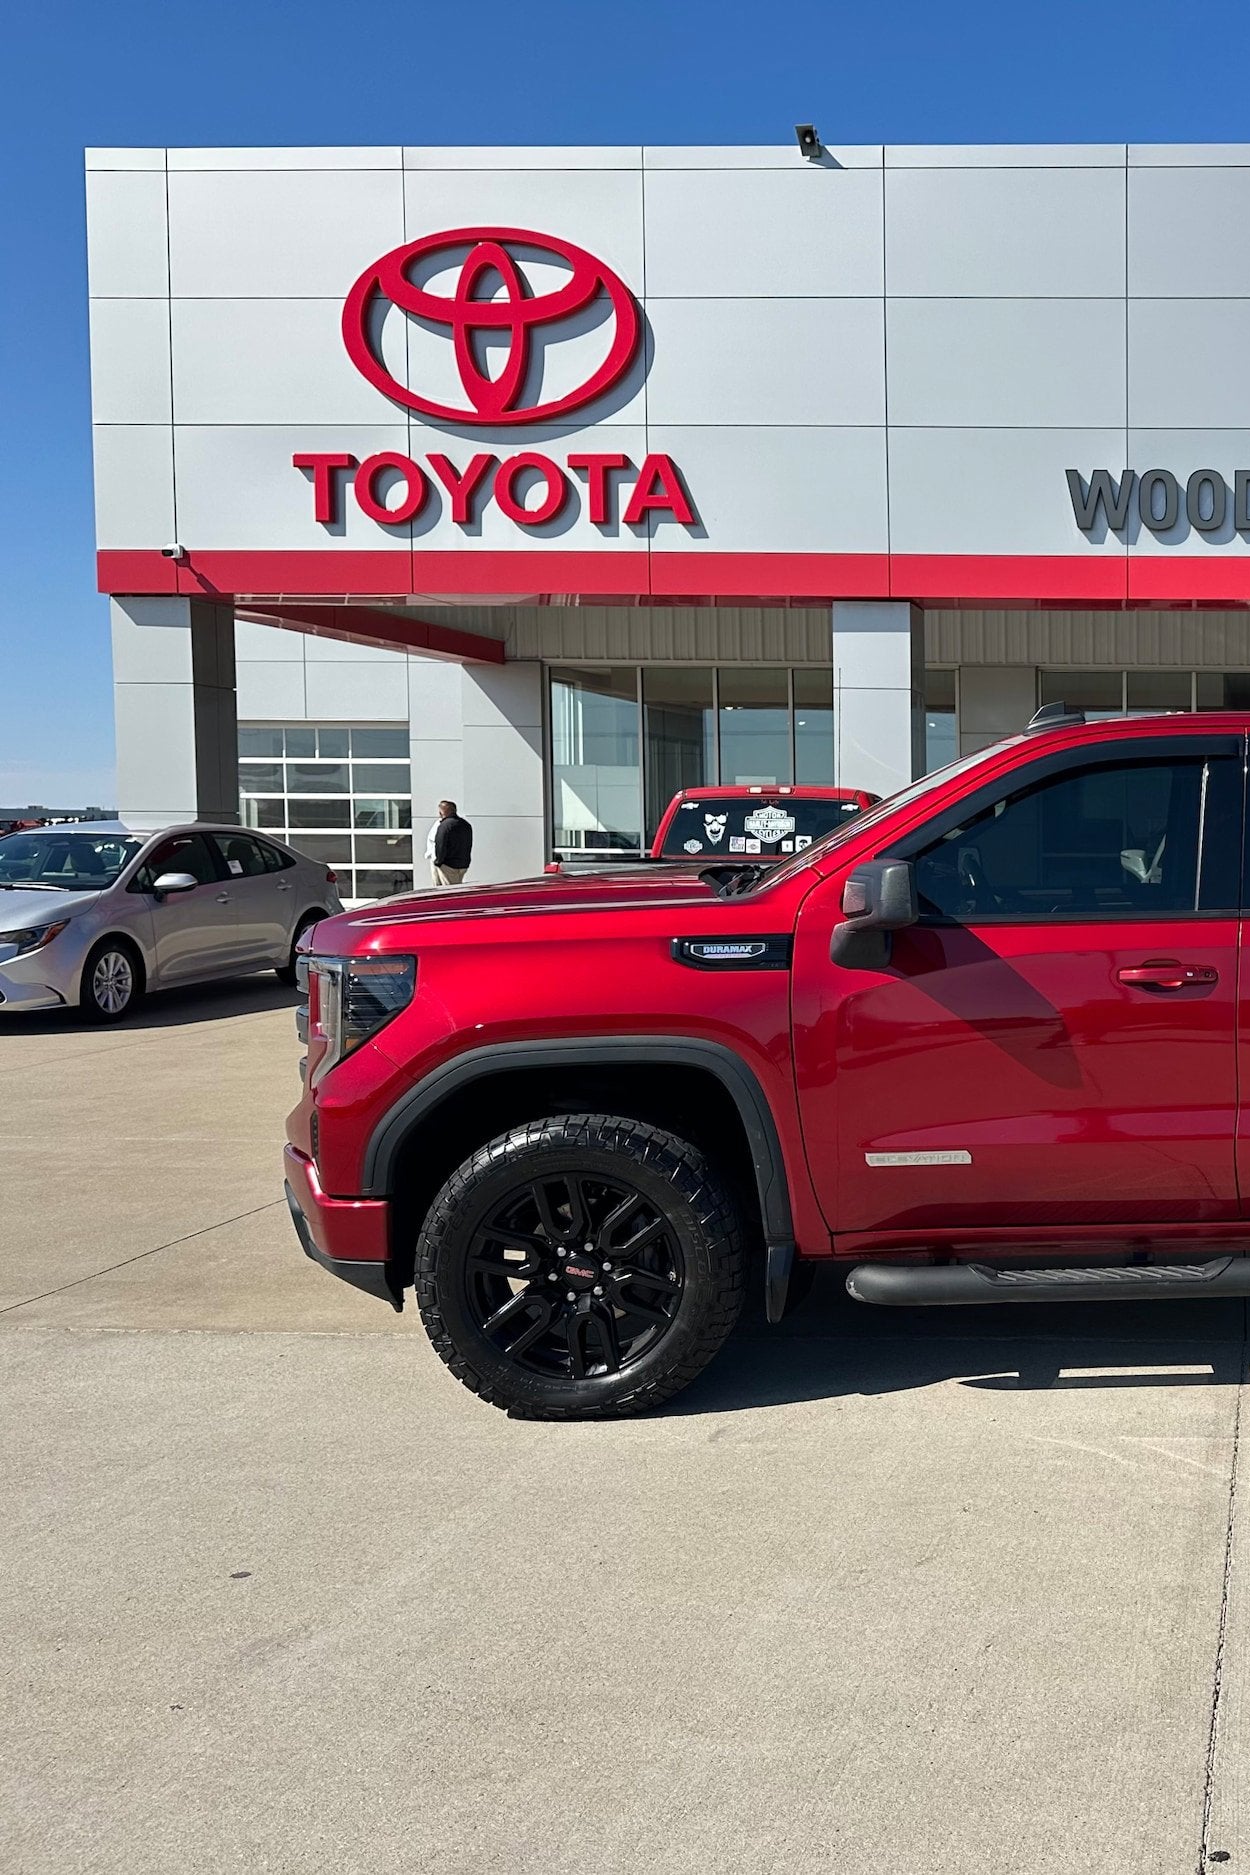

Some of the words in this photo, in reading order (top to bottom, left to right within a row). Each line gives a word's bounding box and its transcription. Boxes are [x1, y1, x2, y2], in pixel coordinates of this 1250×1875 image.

[292, 452, 697, 525] TOYOTA
[703, 945, 753, 954] DURAMAX
[565, 1265, 595, 1279] GMC
